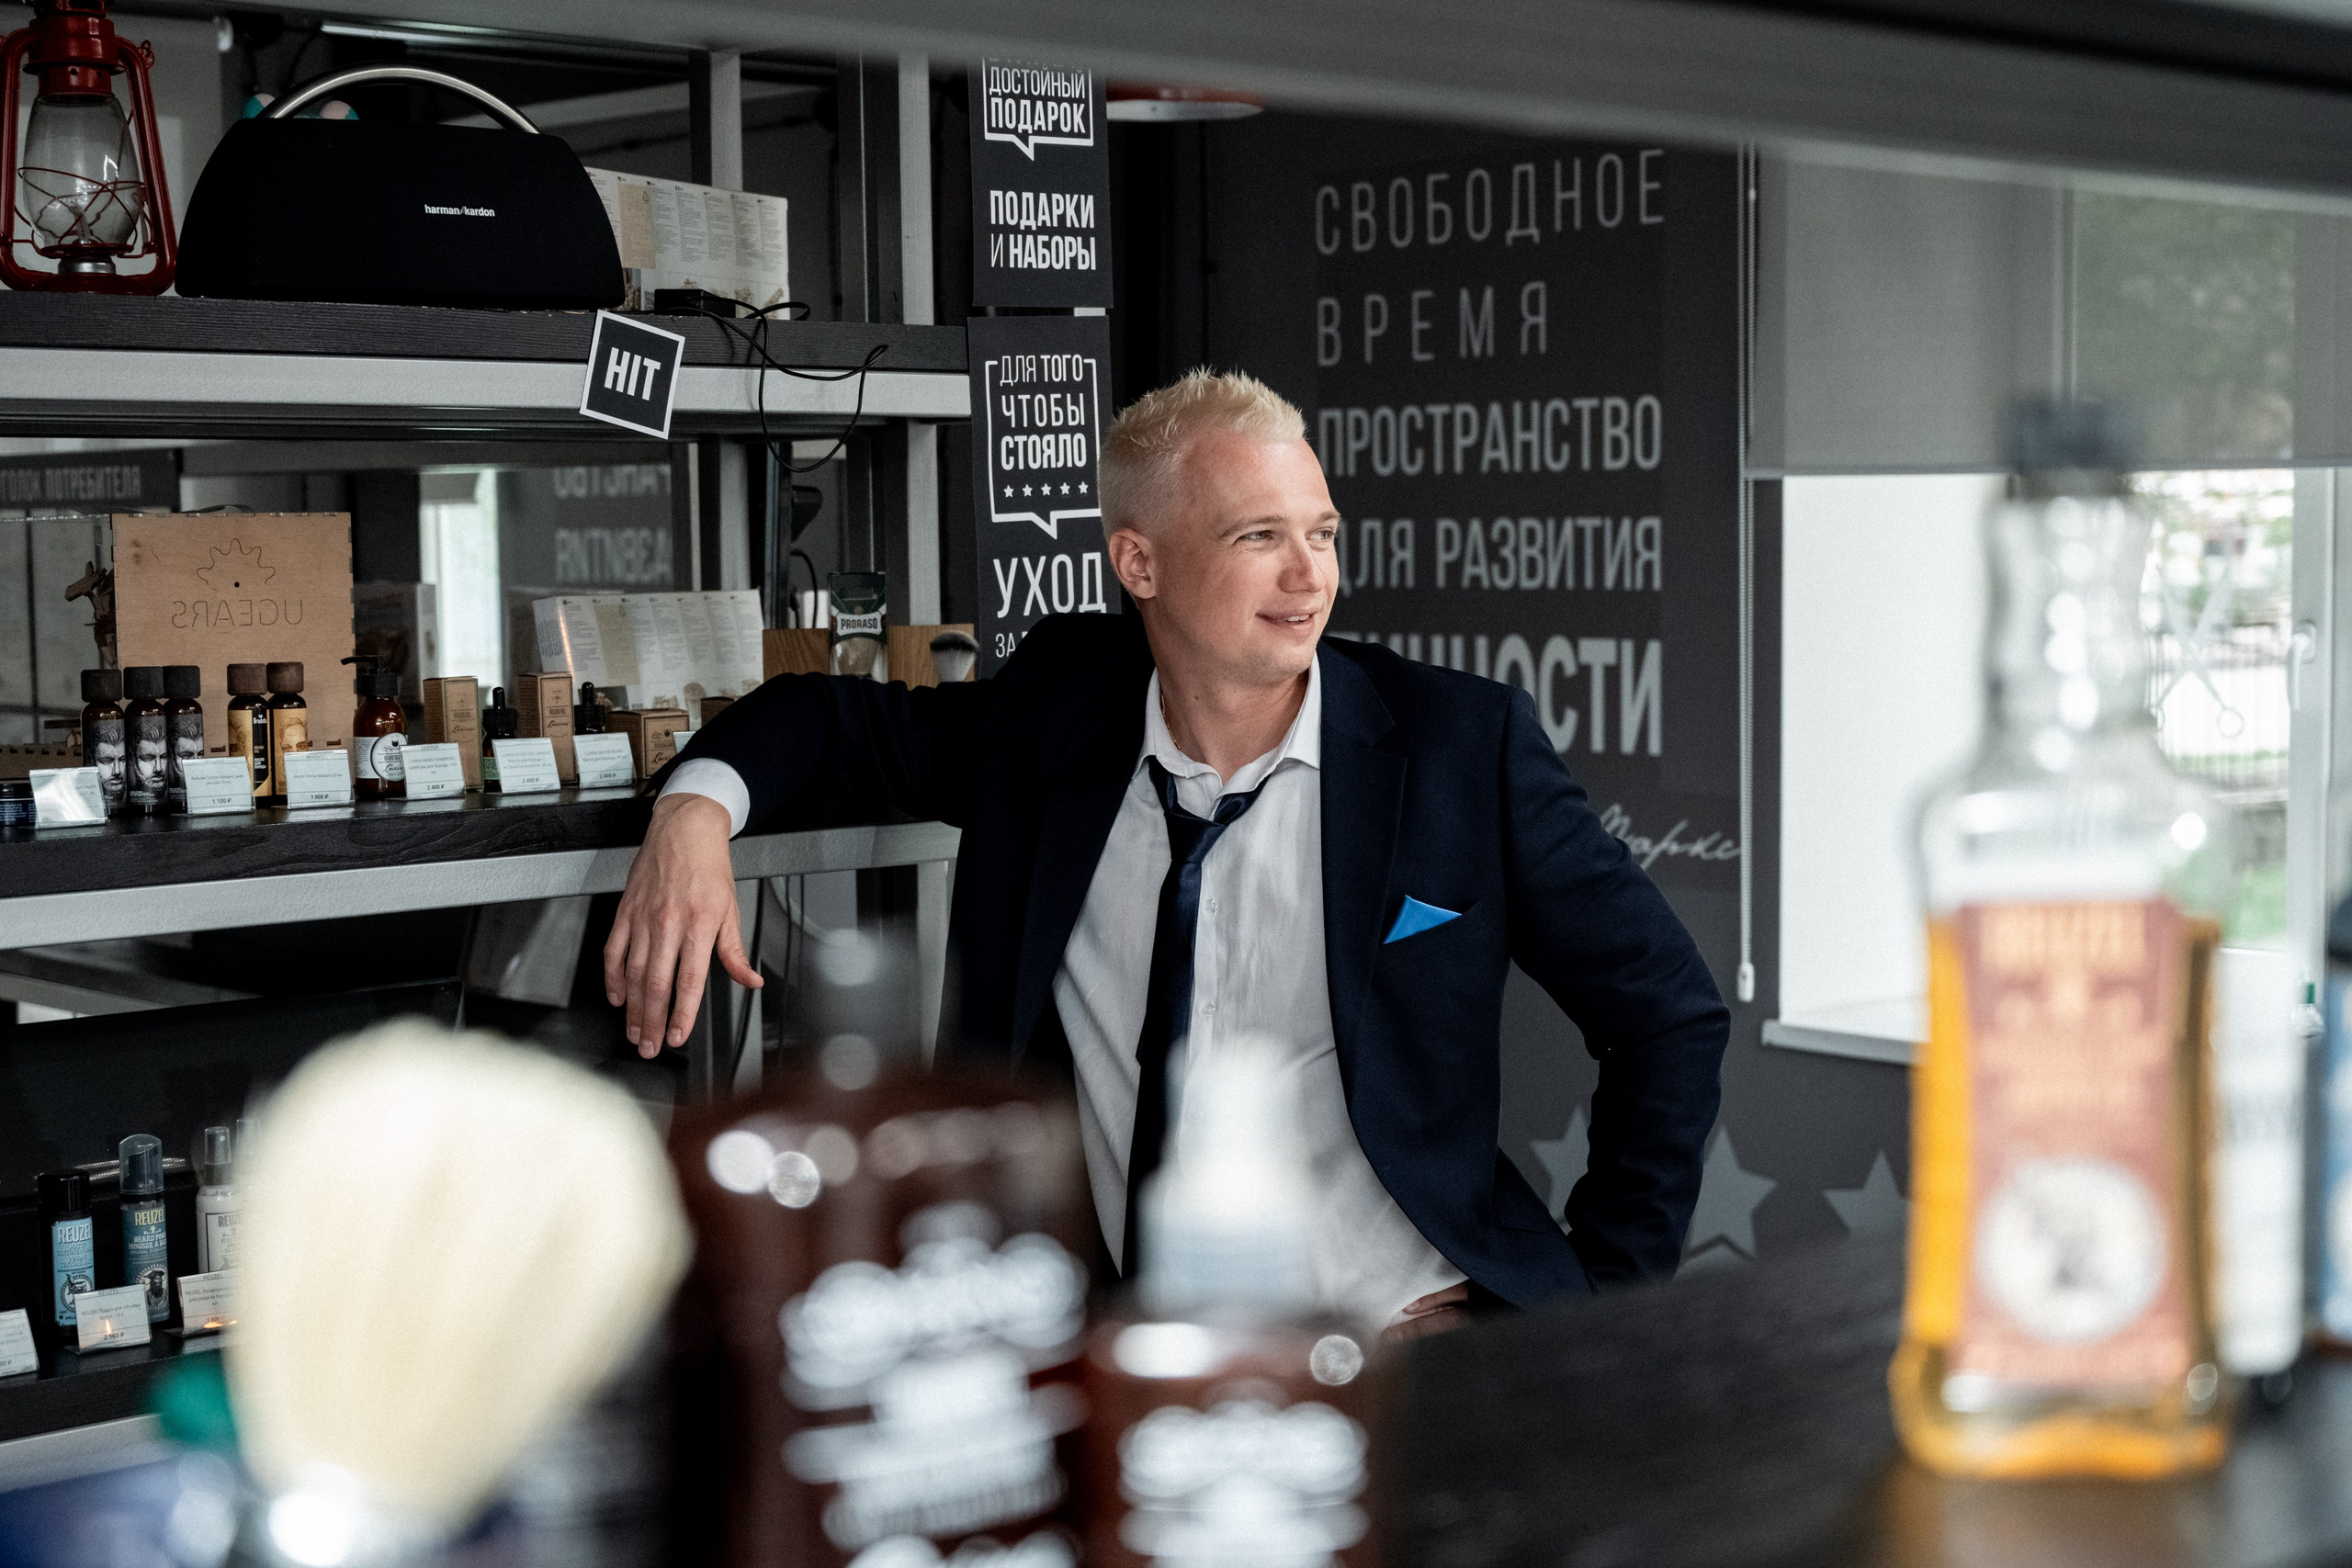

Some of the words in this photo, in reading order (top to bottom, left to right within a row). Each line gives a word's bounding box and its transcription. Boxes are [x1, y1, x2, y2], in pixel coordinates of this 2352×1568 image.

[989, 66, 1086, 99] ДОСТОЙНЫЙ
[989, 96, 1087, 134] ПОДАРОК
[424, 204, 496, 218] harman/kardon
[989, 189, 1095, 231] ПОДАРКИ
[1315, 148, 1665, 256] СВОБОДНОЕ
[990, 232, 1003, 268] И
[1009, 233, 1097, 271] НАБОРЫ
[1317, 280, 1548, 367] ВРЕМЯ
[604, 346, 662, 402] HIT
[1000, 355, 1036, 387] ДЛЯ
[1040, 354, 1083, 382] ТОГО
[1001, 392, 1086, 428] ЧТОБЫ
[1000, 433, 1088, 471] СТОЯЛО
[1317, 394, 1663, 478] ПРОСТРАНСТВО
[1436, 515, 1663, 592] РАЗВИТИЯ
[992, 551, 1107, 619] УХОД
[841, 617, 878, 631] PRORASO
[995, 632, 1016, 658] ЗА
[57, 1223, 92, 1244] REUZEL
[134, 1208, 164, 1226] REUZEL
